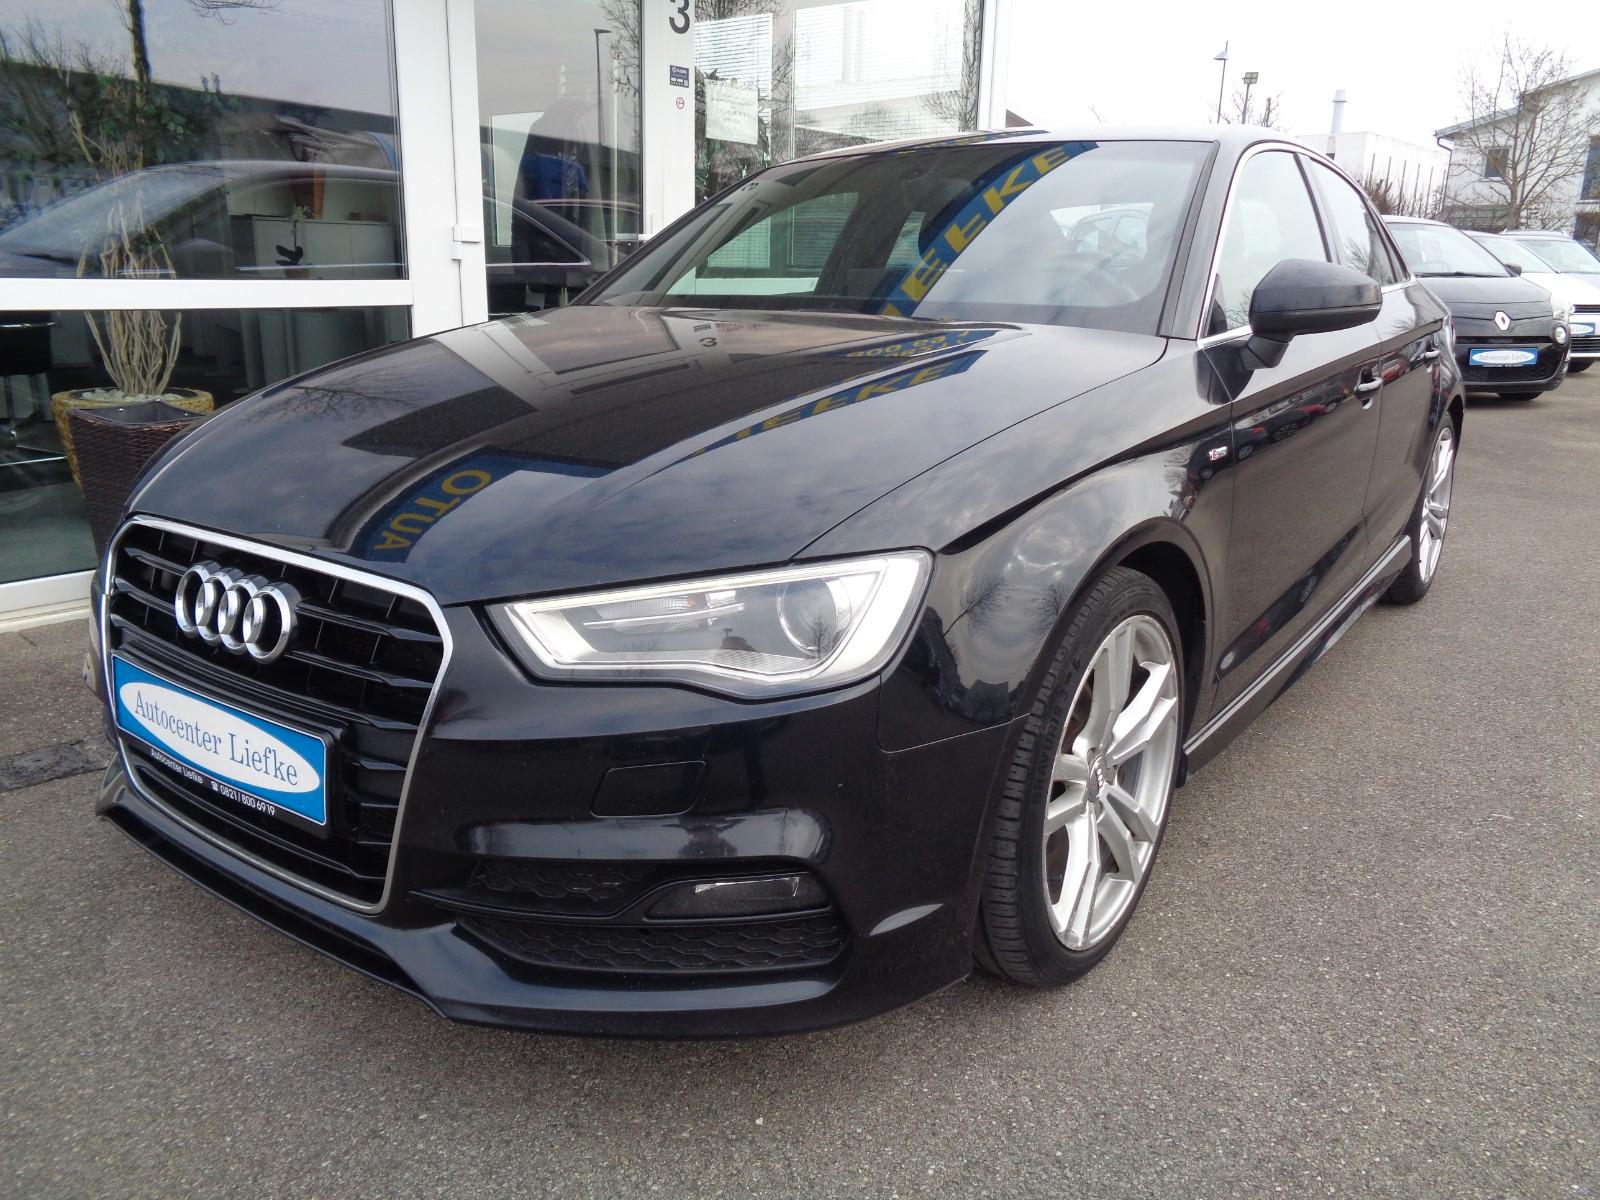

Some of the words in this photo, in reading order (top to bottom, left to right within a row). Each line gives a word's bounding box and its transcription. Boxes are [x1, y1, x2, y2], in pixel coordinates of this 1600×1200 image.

[668, 0, 691, 34] 3
[134, 690, 222, 755] Autocenter
[228, 732, 298, 786] Liefke
[151, 748, 182, 774] Autocenter
[183, 766, 203, 784] Liefke
[220, 785, 238, 800] 0821
